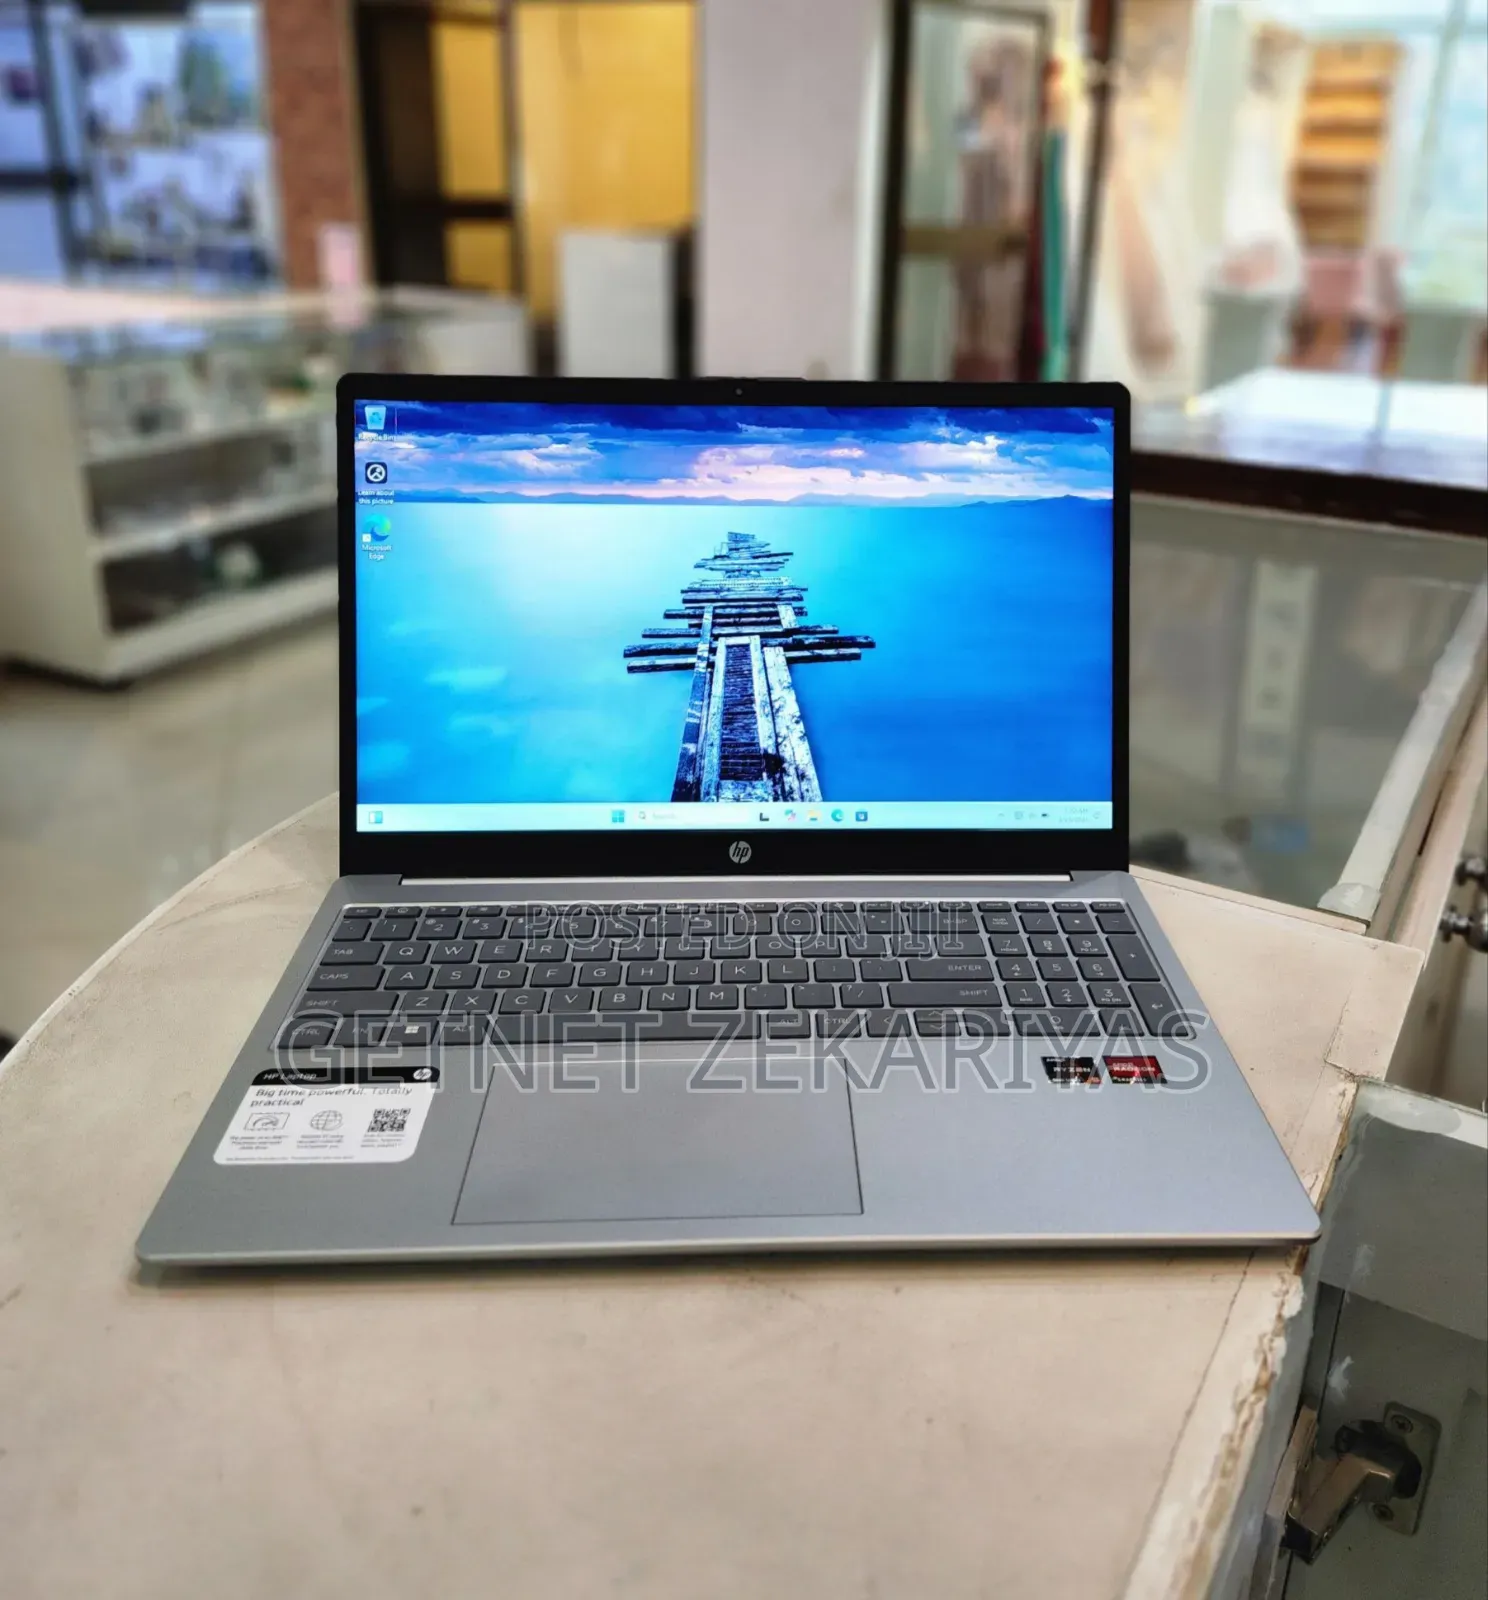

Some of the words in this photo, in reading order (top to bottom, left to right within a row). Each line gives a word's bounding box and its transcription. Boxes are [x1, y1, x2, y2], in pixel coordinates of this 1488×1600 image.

[372, 498, 394, 506] picture
[361, 544, 392, 552] Microsoft
[369, 553, 384, 561] Edge
[729, 841, 752, 864] hp
[434, 923, 444, 931] 2
[1082, 940, 1092, 948] 9
[333, 948, 354, 956] TAB
[399, 947, 414, 956] Q
[444, 946, 463, 955] W
[493, 946, 506, 954] E
[540, 945, 552, 953] R
[641, 967, 654, 976] H
[689, 967, 699, 975] J
[735, 966, 747, 975] K
[782, 964, 793, 974] L
[1052, 963, 1061, 972] 5
[1092, 963, 1102, 972] 6
[319, 972, 349, 980] CAPS
[399, 971, 414, 980] A
[450, 971, 462, 980] S
[497, 970, 511, 979] D
[546, 968, 559, 978] F
[593, 968, 607, 977] G
[662, 992, 675, 1001] N
[709, 991, 724, 1000] M
[1061, 989, 1071, 997] 2
[1103, 989, 1113, 997] 3
[415, 996, 430, 1006] Z
[465, 996, 479, 1005] X
[515, 996, 528, 1004] C
[564, 994, 579, 1003] V
[613, 993, 626, 1003] B
[305, 999, 339, 1007] SHIFT
[256, 1089, 276, 1098] Big
[278, 1088, 305, 1097] time
[307, 1087, 367, 1097] powerful.
[372, 1086, 413, 1096] Totally
[250, 1098, 305, 1108] practical
